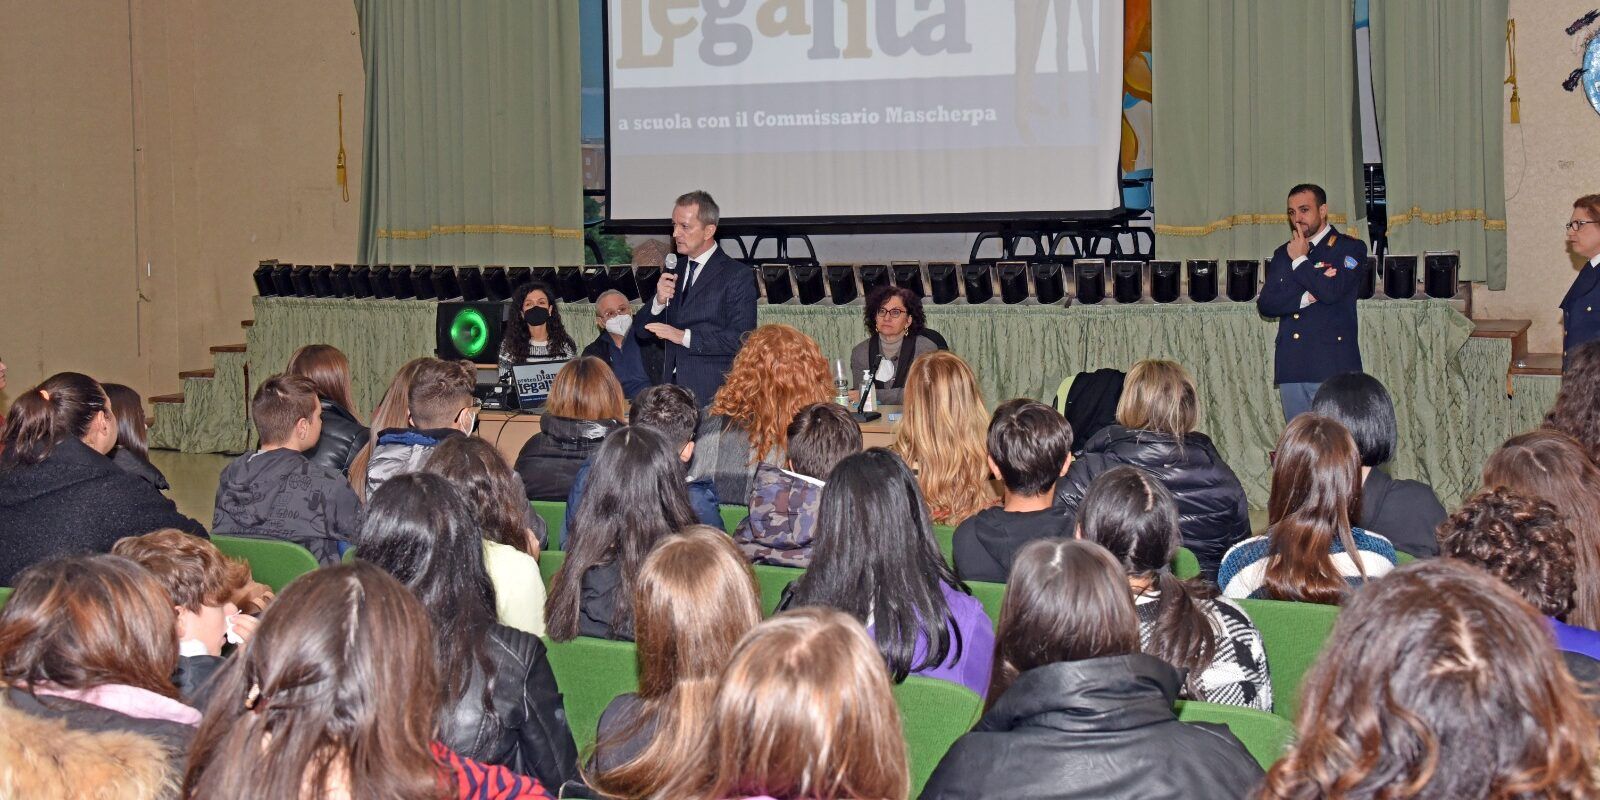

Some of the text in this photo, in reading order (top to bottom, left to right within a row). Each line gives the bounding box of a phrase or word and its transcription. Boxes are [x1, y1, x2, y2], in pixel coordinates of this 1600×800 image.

[618, 105, 998, 131] a scuola con il Commissario Mascherpa
